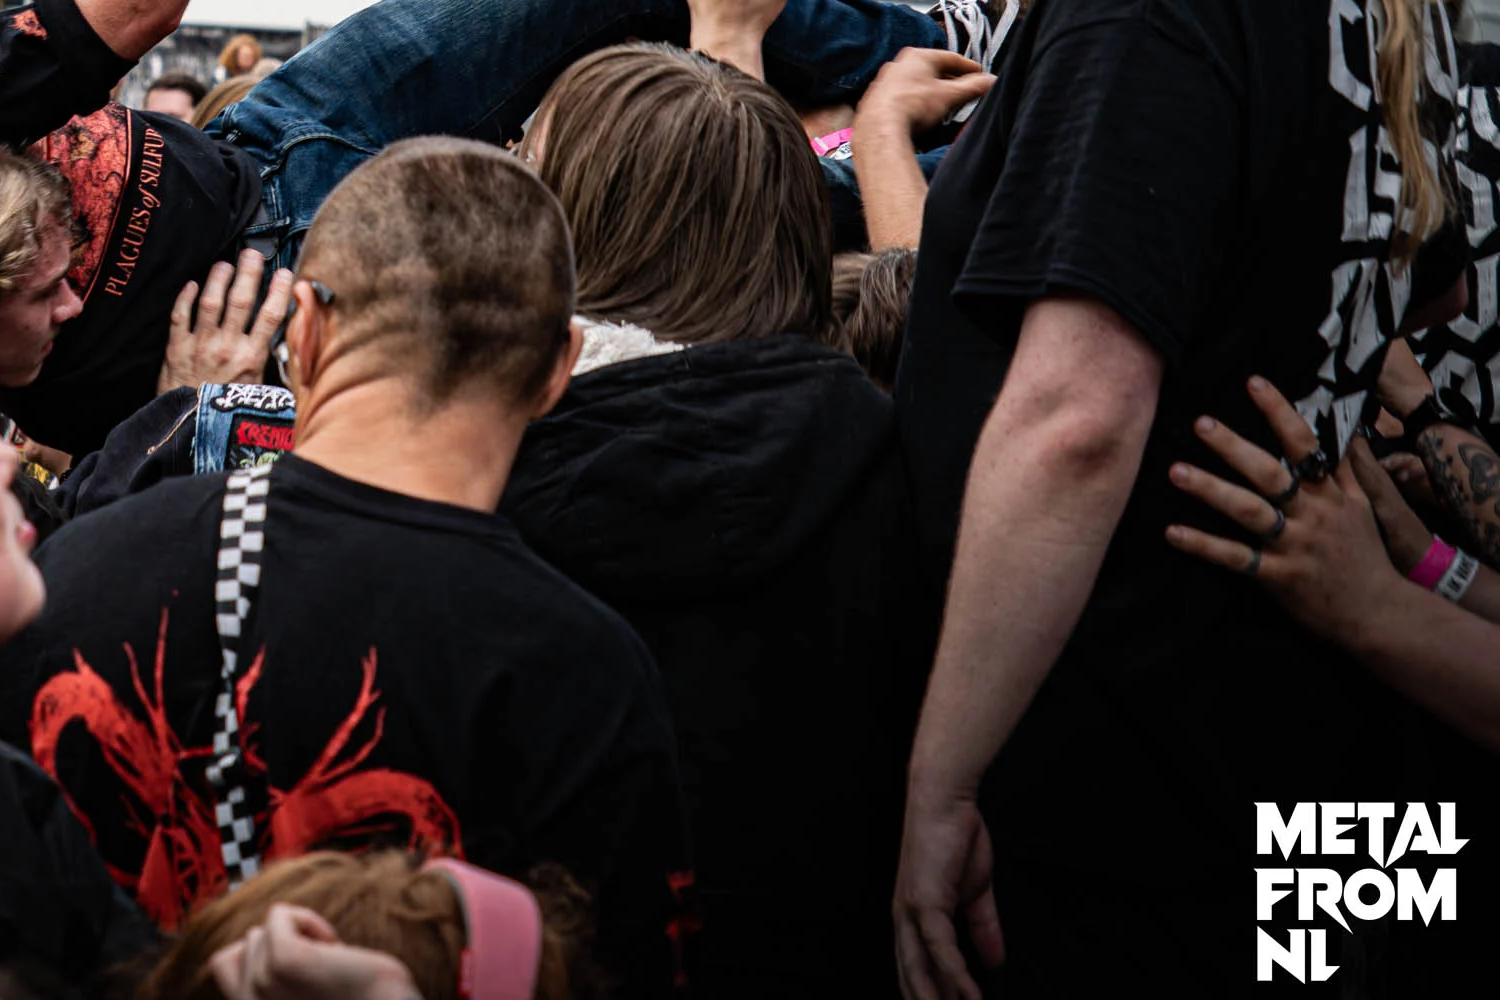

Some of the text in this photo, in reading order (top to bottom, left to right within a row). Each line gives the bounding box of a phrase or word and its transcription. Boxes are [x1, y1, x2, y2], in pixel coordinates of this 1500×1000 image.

[104, 207, 151, 297] PLAGUES
[138, 184, 162, 208] of
[236, 421, 295, 451] KREATO
